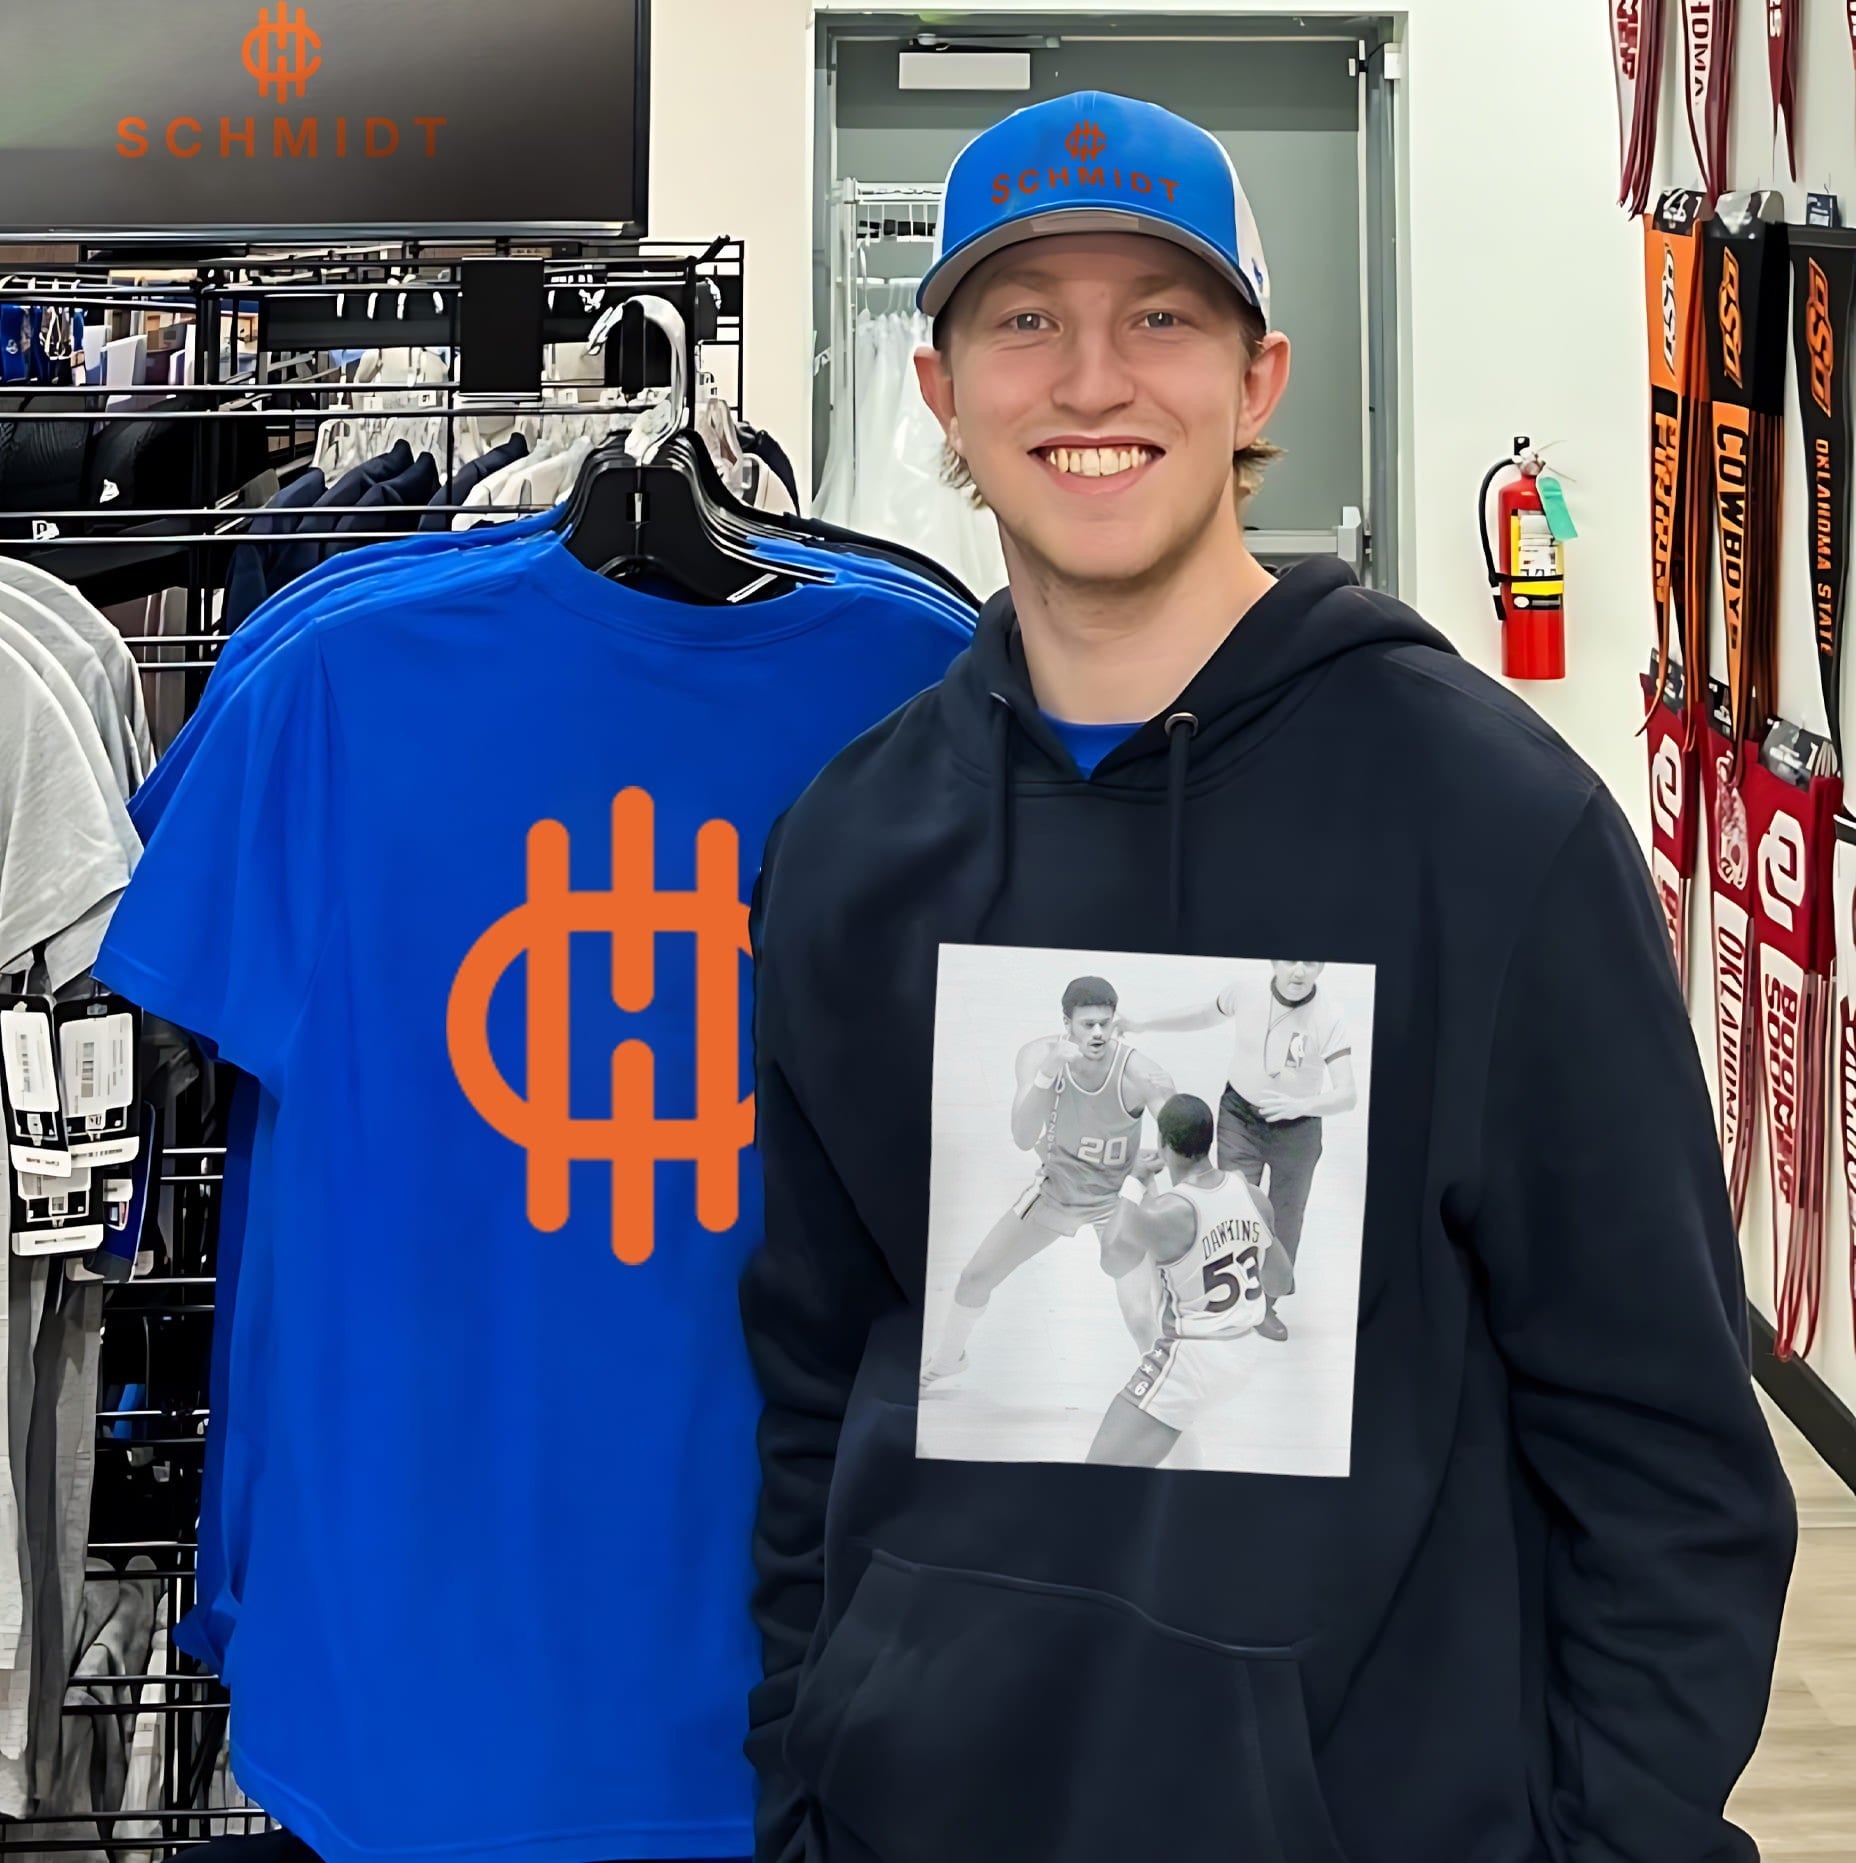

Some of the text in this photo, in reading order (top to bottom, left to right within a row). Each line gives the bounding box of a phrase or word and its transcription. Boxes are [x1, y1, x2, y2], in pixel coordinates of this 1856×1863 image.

[115, 116, 447, 159] SCHMIDT
[991, 167, 1179, 205] SCHMIDT
[1815, 437, 1833, 570] OKLAHOMA
[1077, 1136, 1128, 1166] 20
[1202, 1219, 1261, 1260] DAWKINS
[1202, 1245, 1263, 1314] 53
